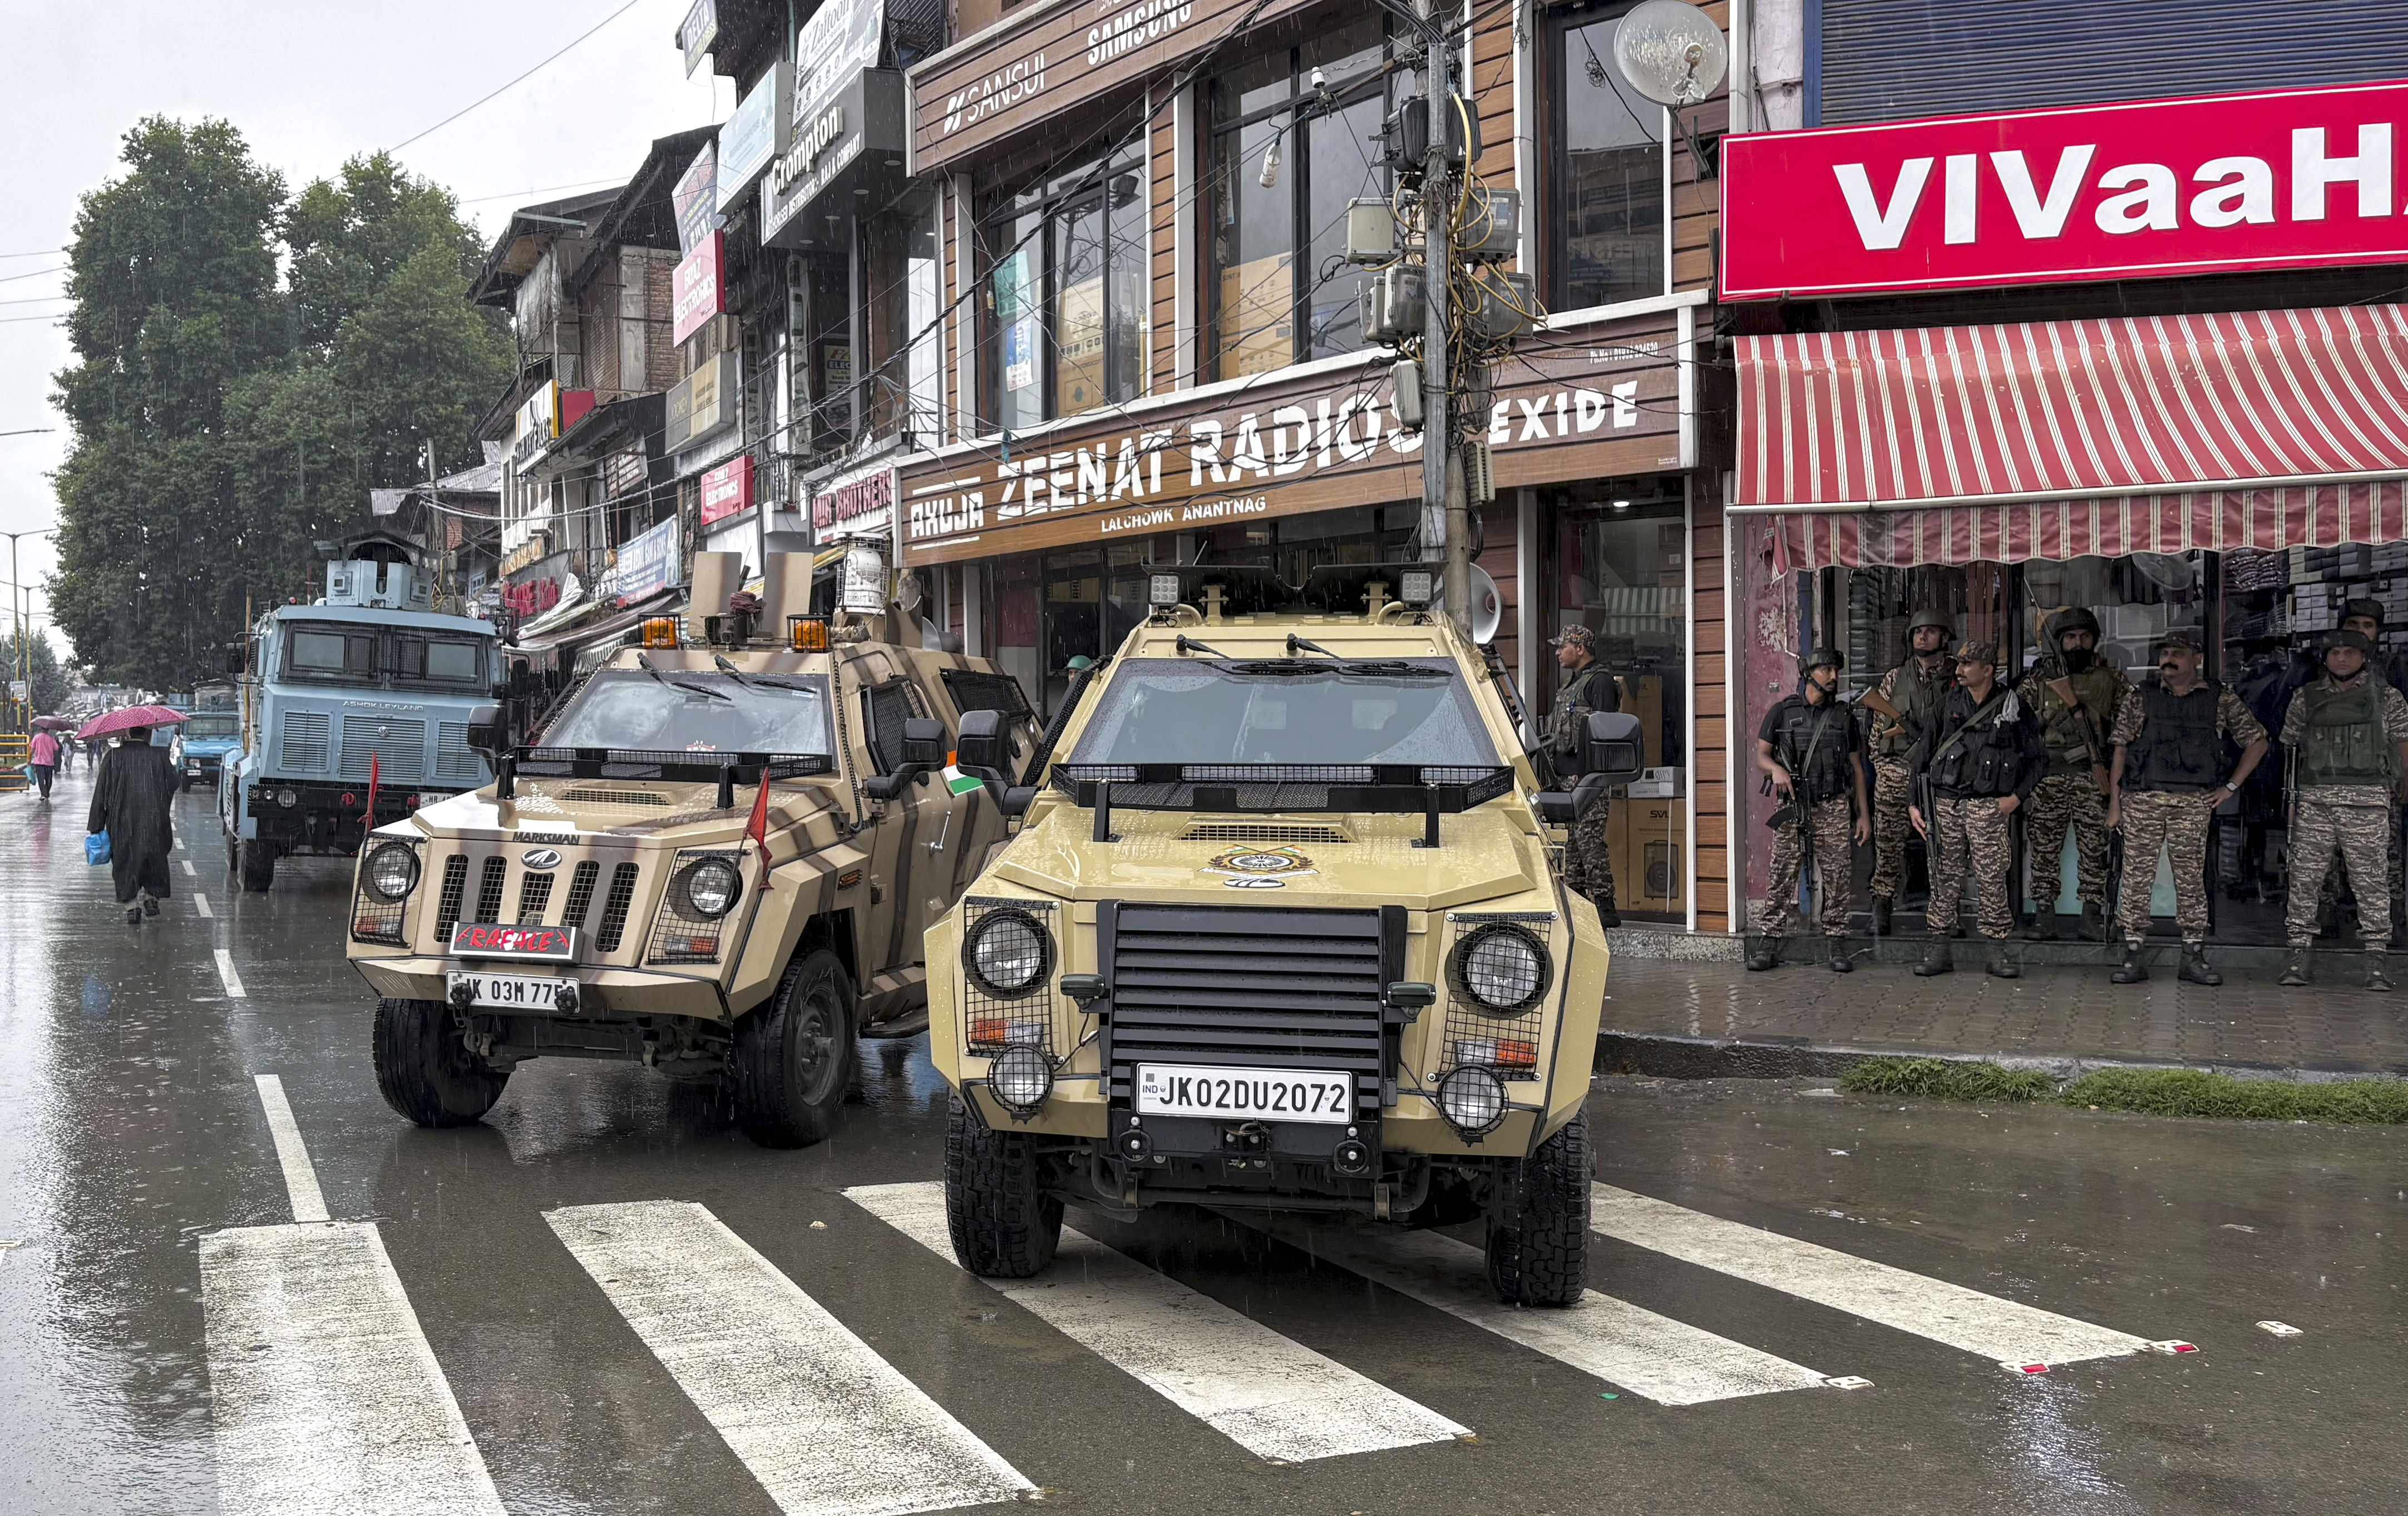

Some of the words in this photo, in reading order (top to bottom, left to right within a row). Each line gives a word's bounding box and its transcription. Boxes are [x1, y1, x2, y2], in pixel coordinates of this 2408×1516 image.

[687, 1, 710, 52] DELTA
[811, 0, 850, 53] Zaitoon
[1087, 0, 1192, 66] SAMSUNG
[966, 53, 1045, 122] SANSUI
[771, 106, 842, 196] Crompton
[821, 161, 832, 186] RAJ
[837, 131, 861, 170] COMPANY
[1832, 122, 2408, 250] VIVaaH
[675, 272, 715, 326] ELECTRONICS
[684, 256, 702, 291] FAYAZ
[1488, 380, 1638, 445] EXIDE
[705, 479, 739, 507] ELECTRONICS
[812, 492, 833, 529] MIR
[836, 467, 892, 521] BROTHERS
[997, 429, 1173, 521] ZEENAT
[911, 491, 984, 539] AHUJA
[1101, 508, 1173, 534] LALCHOWK
[1182, 496, 1266, 521] ANANTNAG
[379, 703, 424, 712] LEYLAND
[512, 831, 581, 845] MARKSMAN
[1142, 1085, 1158, 1094] IND
[1159, 1076, 1346, 1114] JK02DU2072
